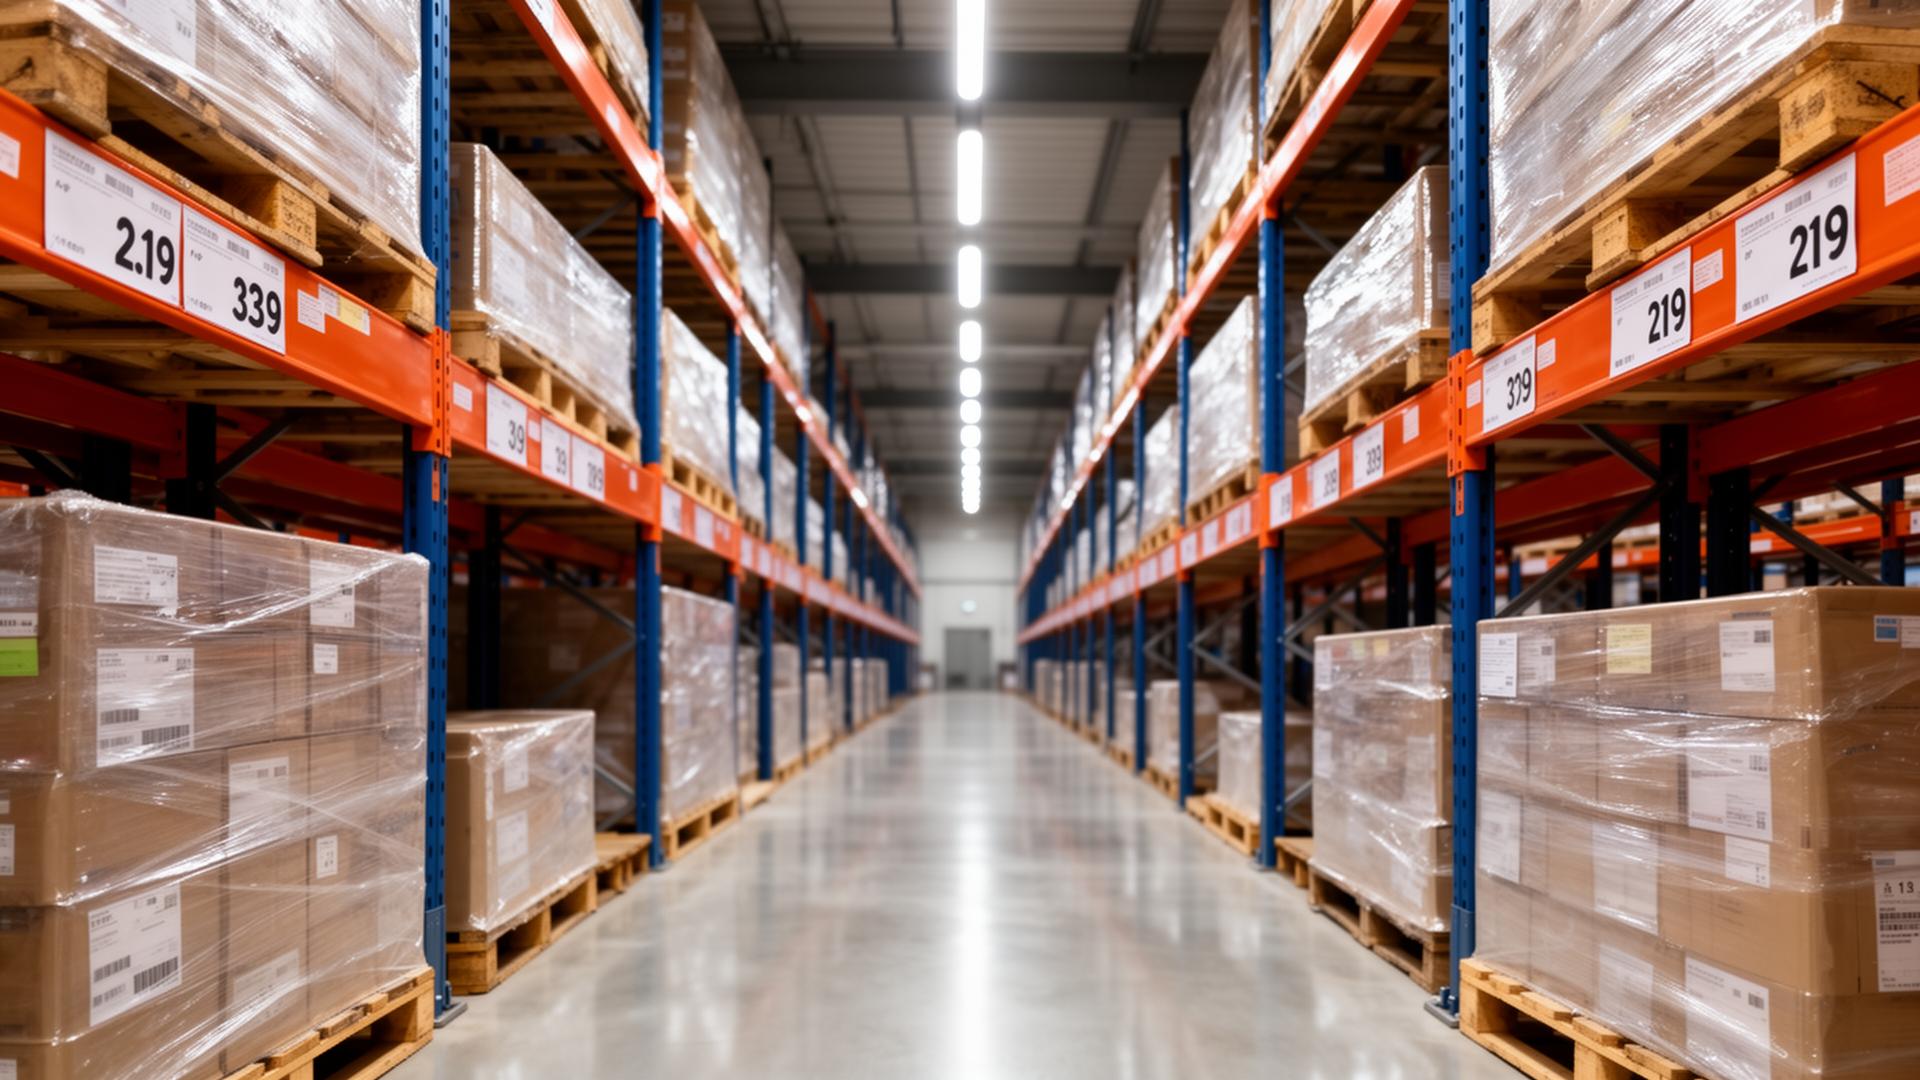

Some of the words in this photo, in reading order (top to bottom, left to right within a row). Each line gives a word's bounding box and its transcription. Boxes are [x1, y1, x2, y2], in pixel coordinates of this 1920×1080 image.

[115, 216, 175, 285] 2.19
[1790, 204, 1849, 280] 219
[232, 276, 282, 335] 339
[1648, 287, 1687, 344] 219
[508, 419, 526, 454] 39
